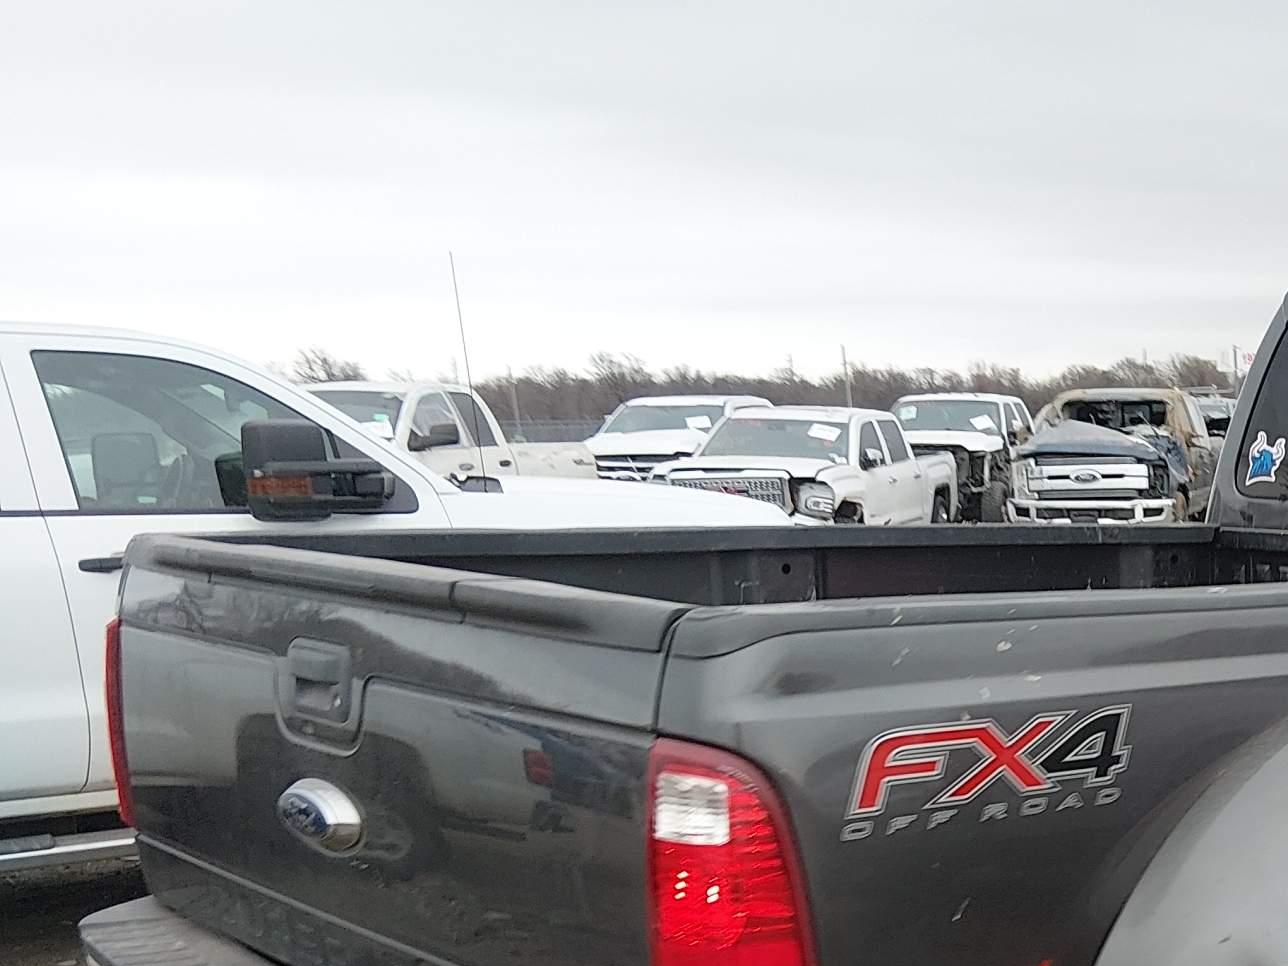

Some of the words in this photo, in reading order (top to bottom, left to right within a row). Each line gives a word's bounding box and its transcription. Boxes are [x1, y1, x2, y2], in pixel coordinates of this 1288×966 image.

[844, 703, 1133, 820] FX4
[840, 810, 959, 842] OFF
[981, 788, 1122, 821] ROAD
